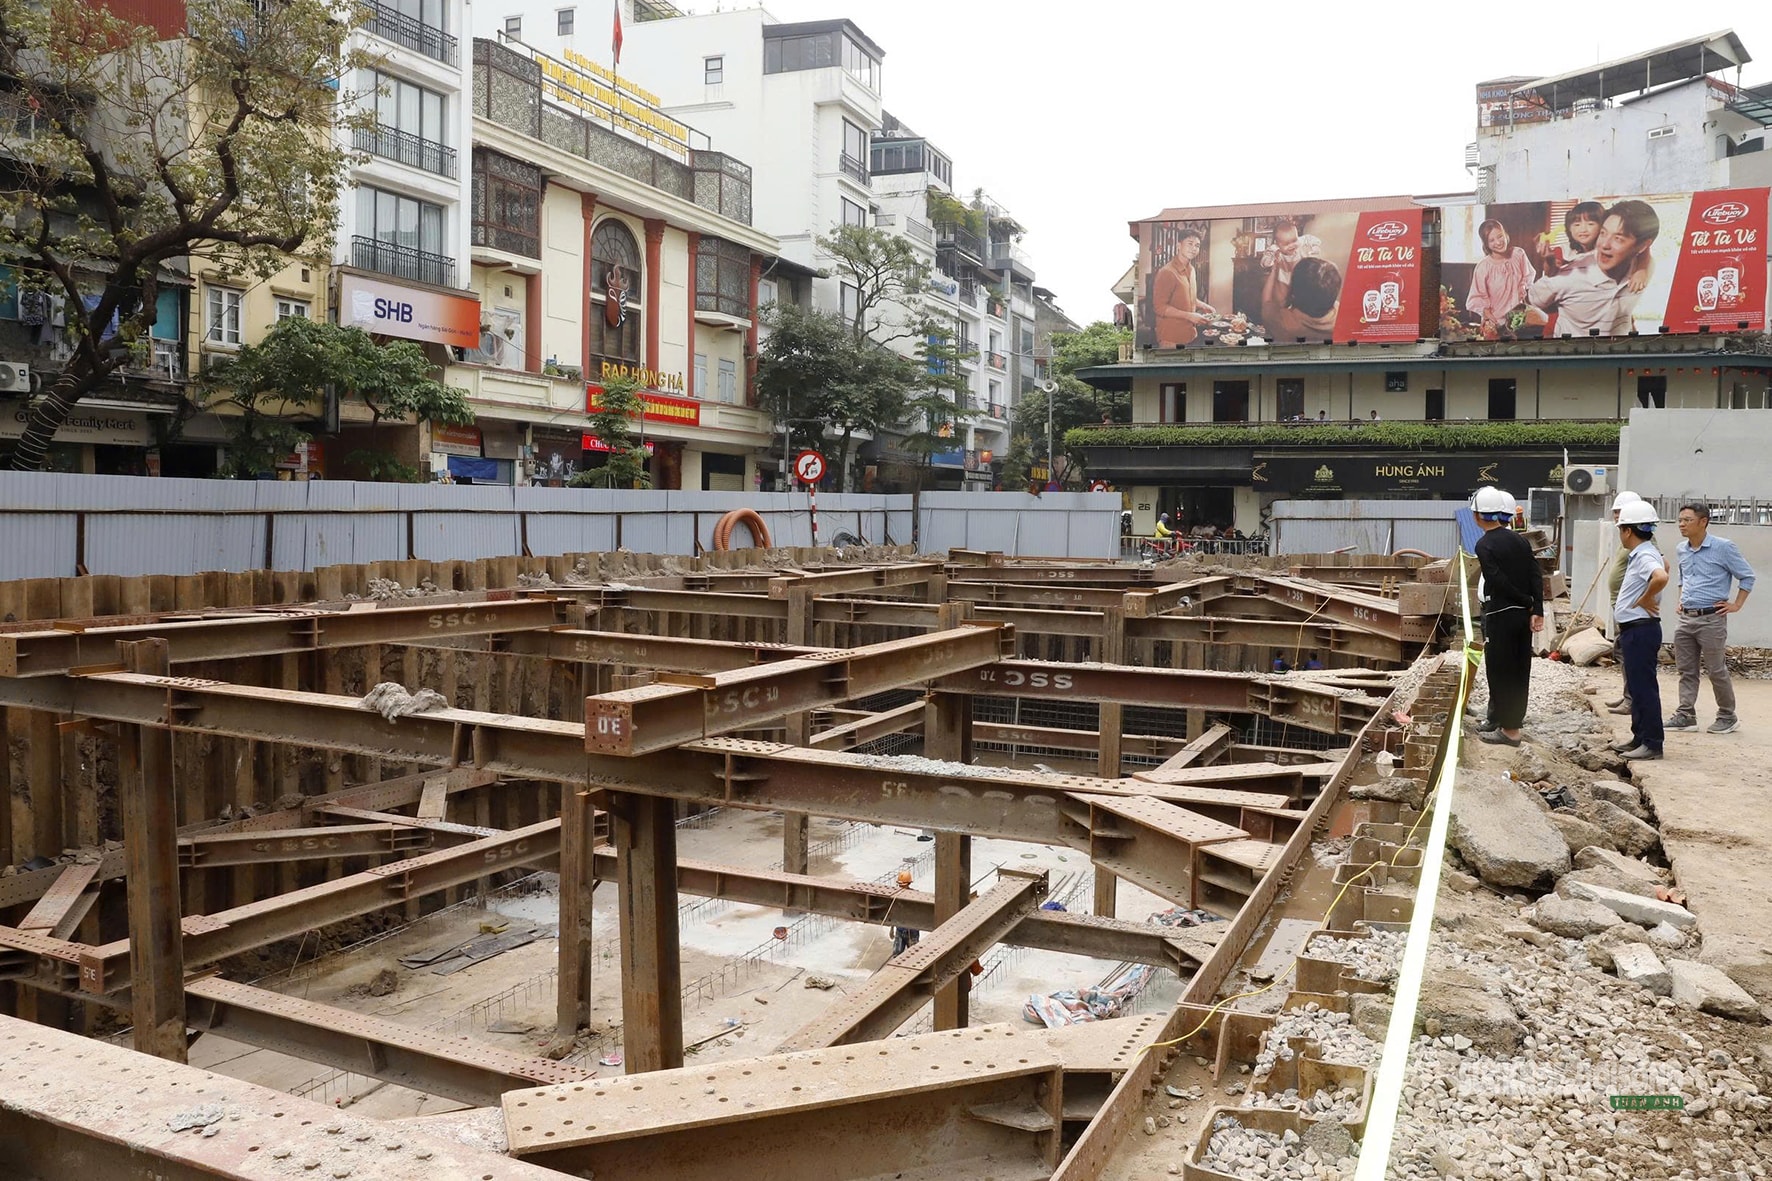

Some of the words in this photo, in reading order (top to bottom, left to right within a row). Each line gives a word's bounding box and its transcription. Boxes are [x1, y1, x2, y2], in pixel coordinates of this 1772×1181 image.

[1707, 208, 1744, 217] Lifebuoy
[1713, 230, 1732, 245] Ta
[1377, 246, 1393, 261] Ta
[374, 298, 413, 323] SHB
[667, 371, 684, 391] HÀ
[66, 415, 105, 431] Family
[107, 420, 135, 431] Mart
[1375, 463, 1413, 477] HÙNG
[1416, 462, 1445, 477] ÁNH
[1138, 503, 1150, 511] 26
[428, 613, 476, 629] SSC
[1353, 607, 1370, 621] SSC
[1004, 670, 1073, 690] SSC
[1302, 696, 1334, 715] SSC
[1264, 753, 1305, 763] SSC
[484, 840, 529, 863] SSC
